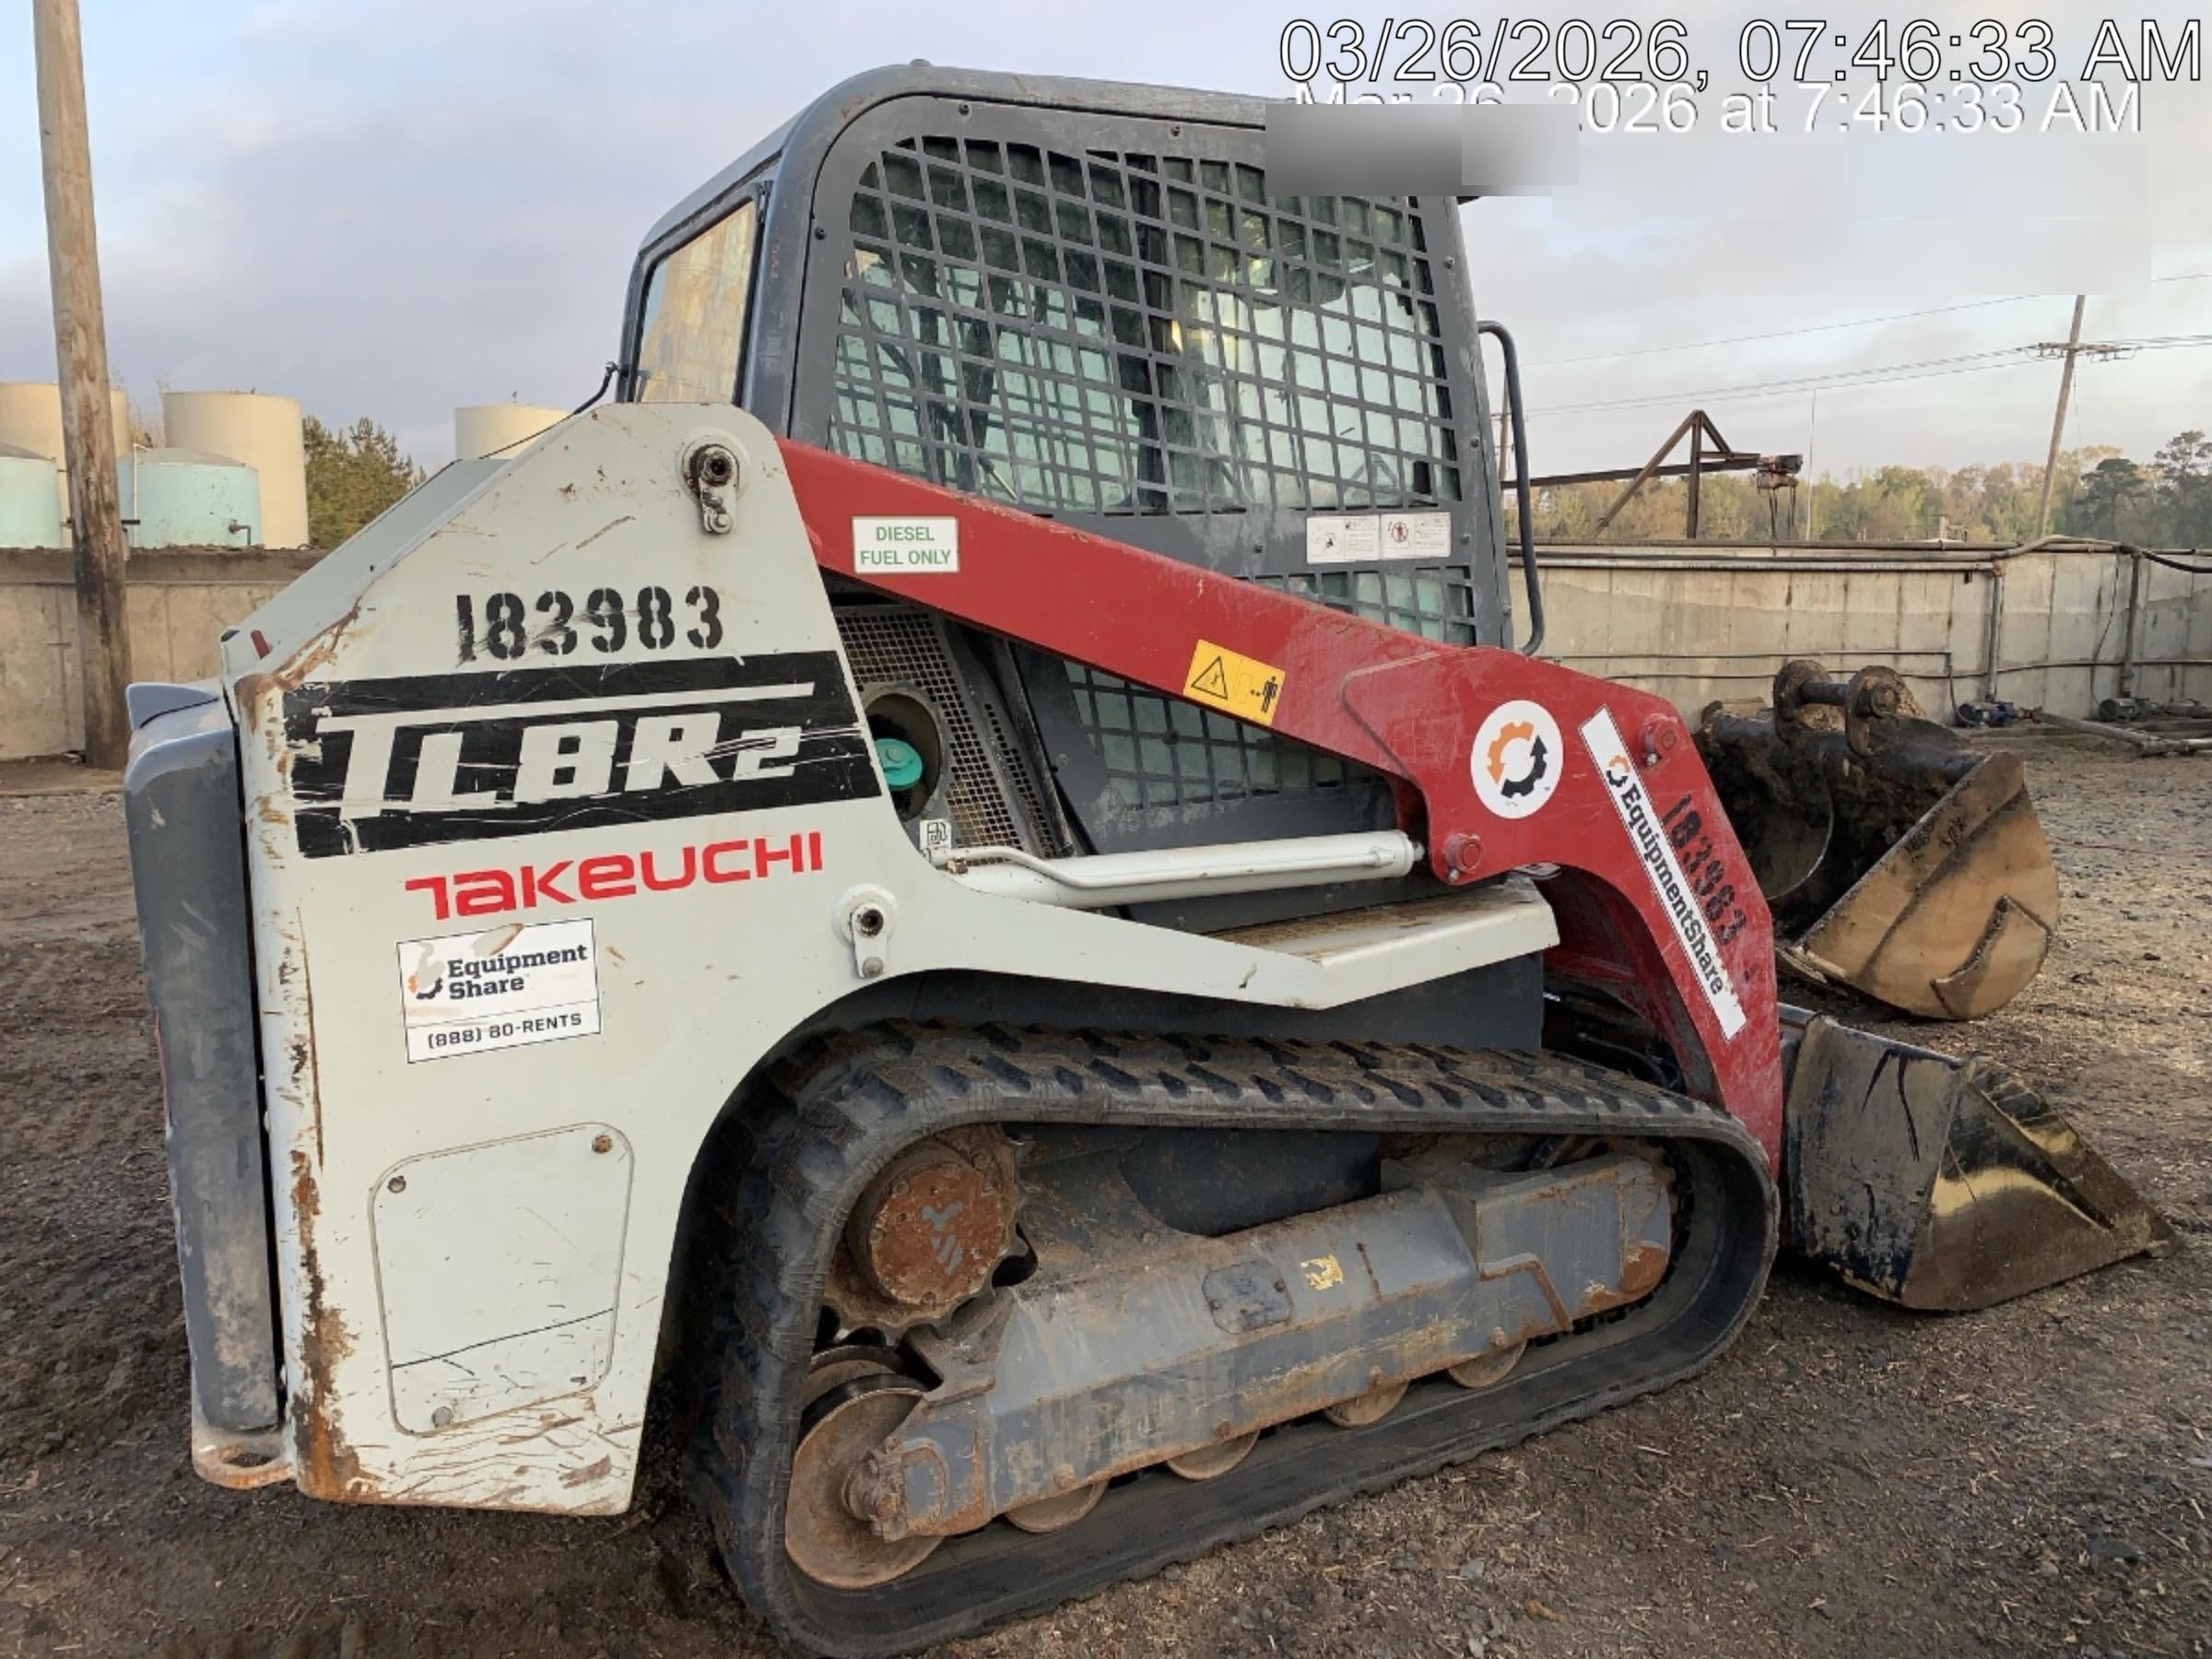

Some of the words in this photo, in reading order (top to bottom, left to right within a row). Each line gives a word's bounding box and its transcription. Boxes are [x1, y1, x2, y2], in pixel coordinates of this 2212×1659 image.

[876, 526, 935, 541] DIESEL
[860, 550, 903, 565] FUEL
[908, 549, 951, 565] ONLY
[455, 586, 724, 667] 183983
[1619, 782, 1724, 995] EquipmentShare
[447, 944, 588, 979] Equipment
[448, 977, 525, 1000] Share
[428, 1028, 482, 1049] (888)
[489, 1013, 582, 1039] 80-RENTS
